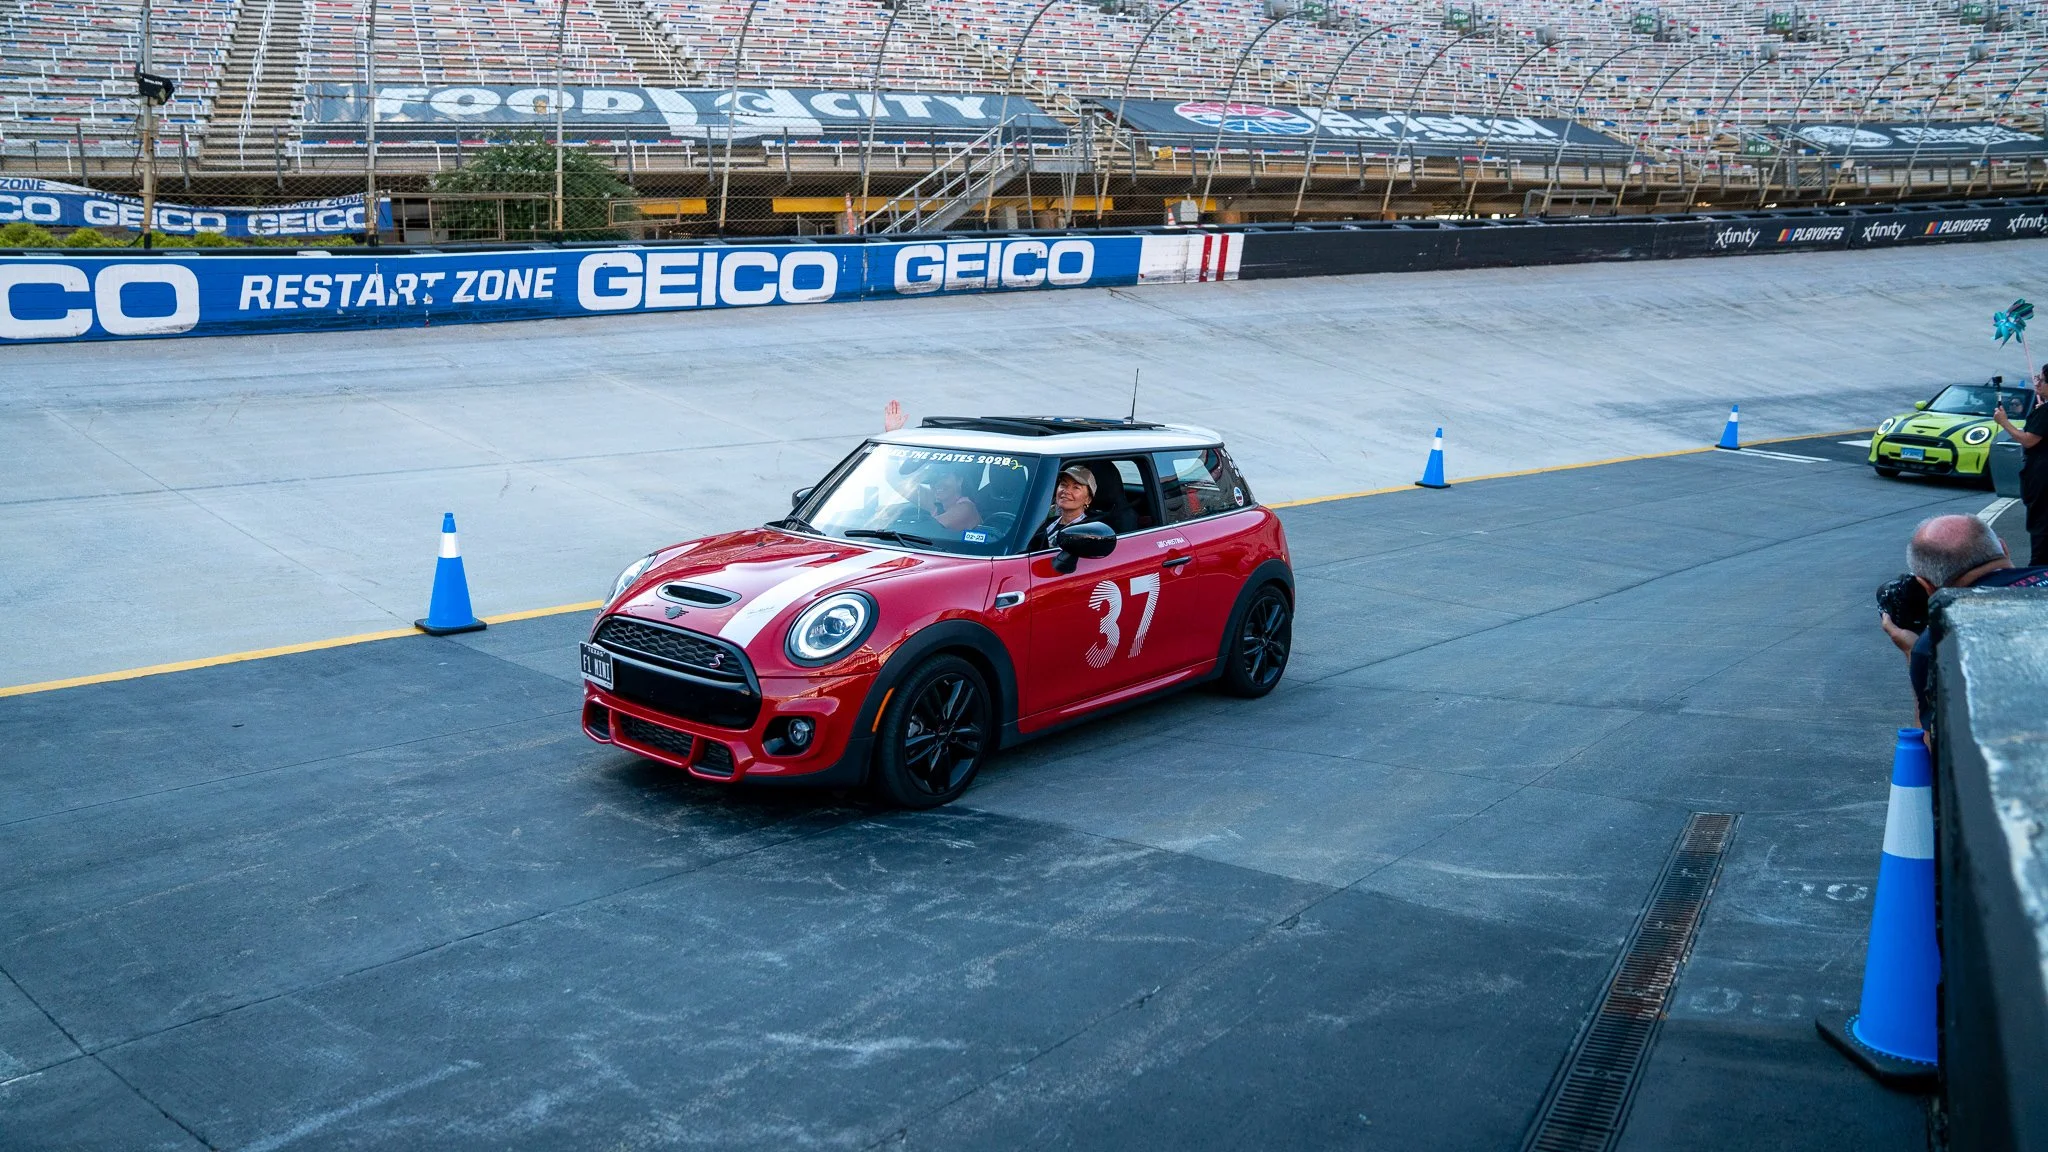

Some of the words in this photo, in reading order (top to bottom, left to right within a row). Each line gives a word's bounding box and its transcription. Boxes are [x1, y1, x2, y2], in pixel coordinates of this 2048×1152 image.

[373, 87, 645, 115] FOOD
[810, 92, 985, 119] CITY
[1297, 106, 1559, 137] Bristol
[0, 178, 47, 190] ZONE
[83, 200, 227, 234] GEICO
[247, 207, 377, 236] GEICO
[1862, 221, 1906, 242] xfinity
[1938, 217, 1992, 234] PLAYOFFS
[1715, 226, 1760, 248] xfinity
[1791, 225, 1844, 242] PLAYOFFS
[578, 250, 839, 311] GEICO
[893, 240, 1096, 295] GEICO
[238, 272, 446, 310] RESTART
[452, 267, 557, 303] ZONE
[930, 452, 974, 463] STATES
[1085, 571, 1161, 669] 37
[583, 654, 592, 673] F1
[593, 657, 611, 681] MINI
